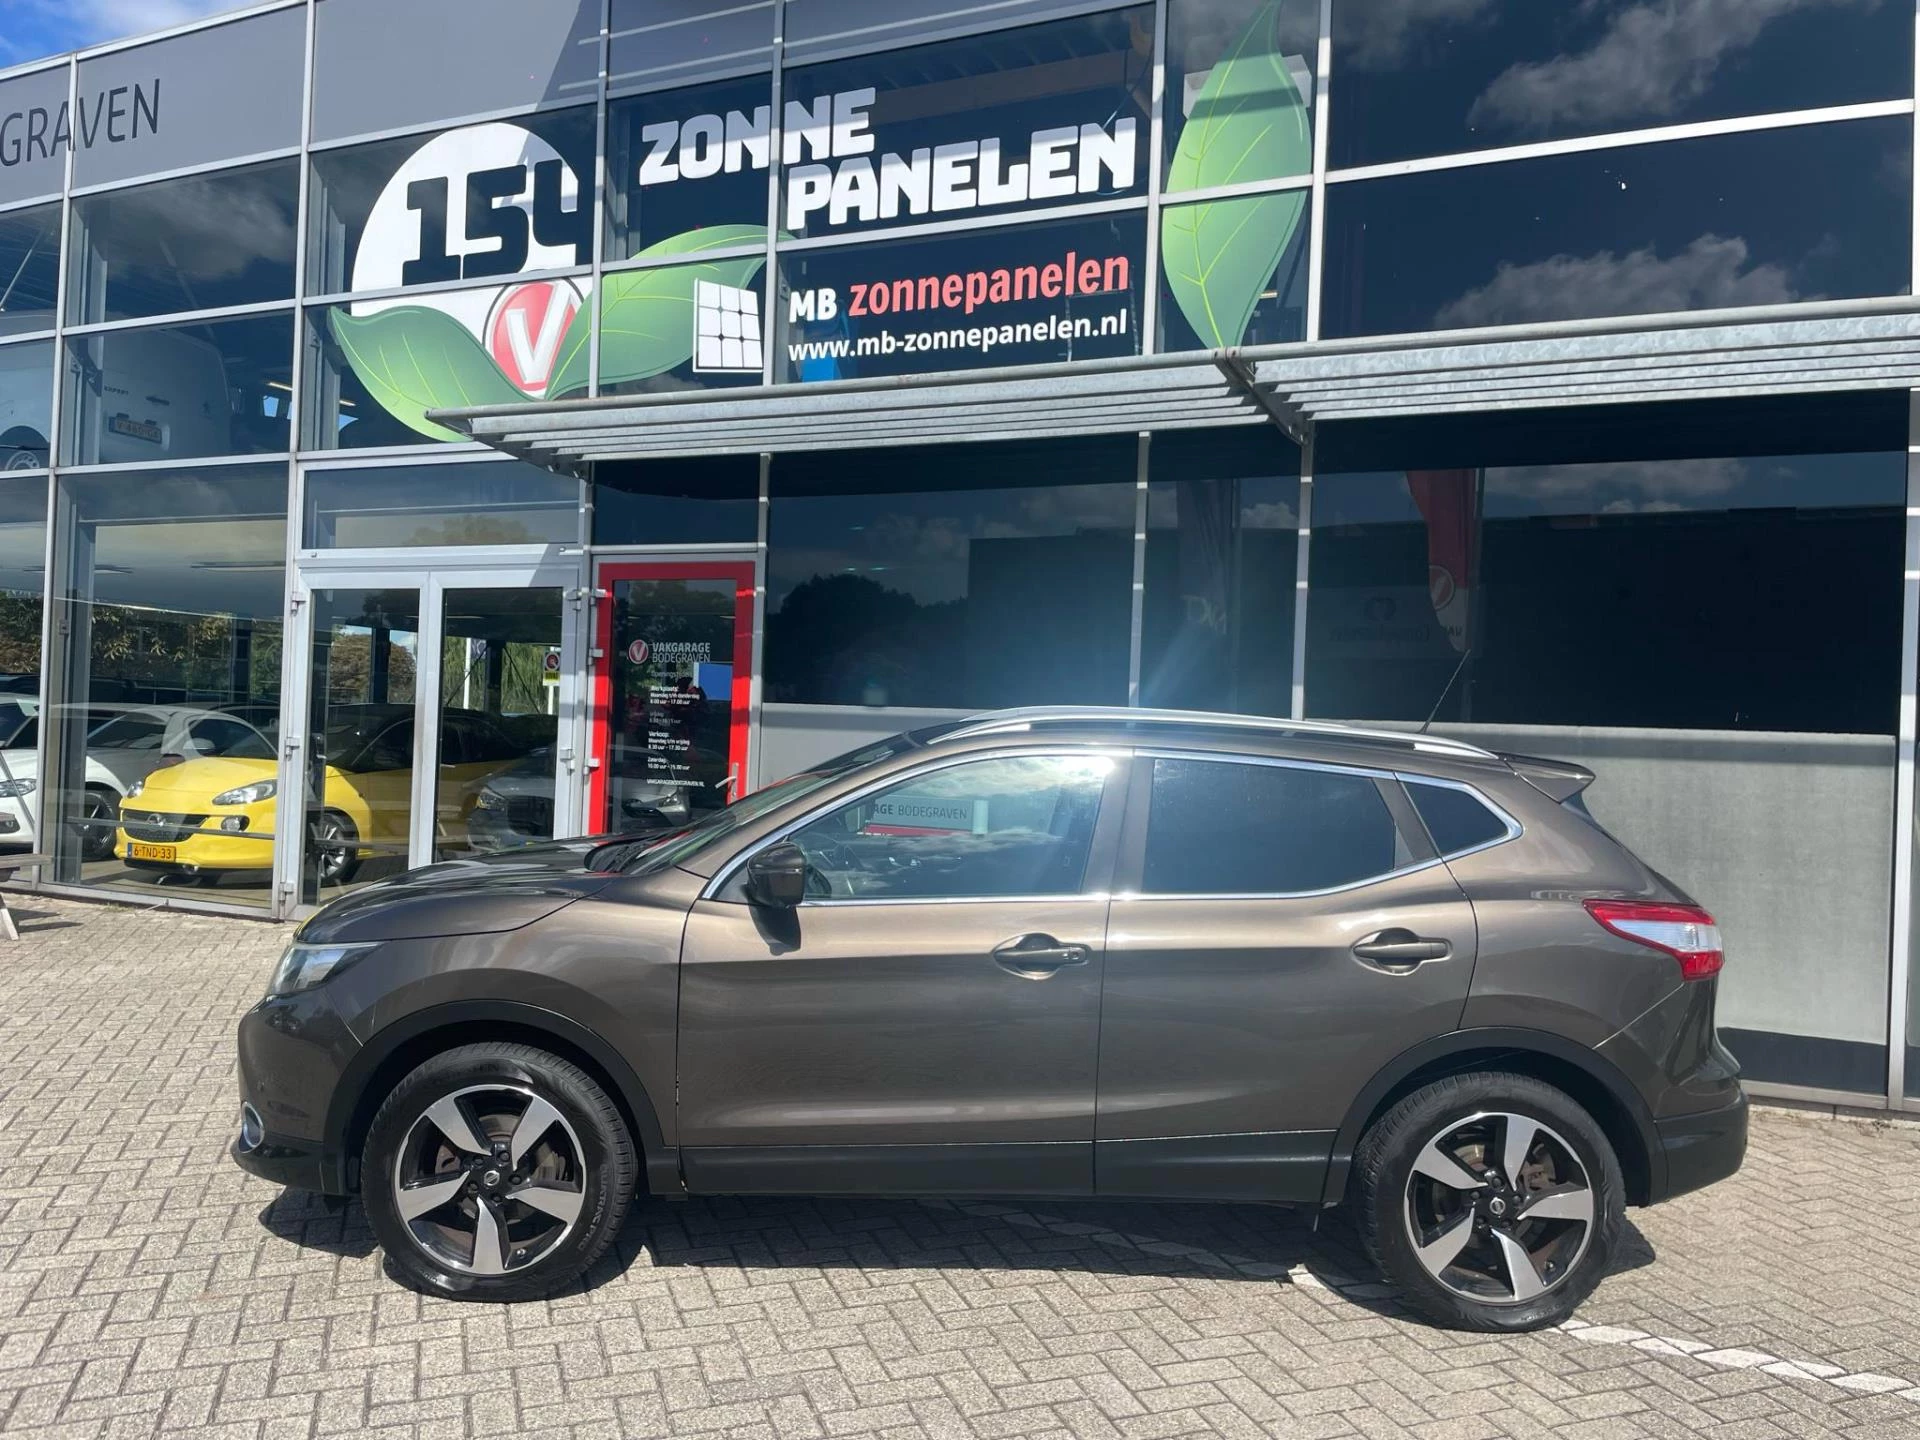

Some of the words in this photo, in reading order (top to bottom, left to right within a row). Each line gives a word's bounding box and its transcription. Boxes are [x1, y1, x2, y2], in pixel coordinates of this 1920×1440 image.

[640, 87, 877, 187] ZONNE
[787, 117, 1137, 231] PANELEN
[402, 159, 593, 286] 154
[788, 288, 838, 324] MB
[848, 251, 1130, 317] zonnepanelen
[788, 308, 1128, 363] www.mb-zonnepanelen.nl
[652, 642, 711, 653] VAKGARAGE
[652, 652, 711, 664] BODEGRAVEN
[897, 804, 968, 819] BODEGRAVEN
[134, 846, 172, 859] 6-TND-33
